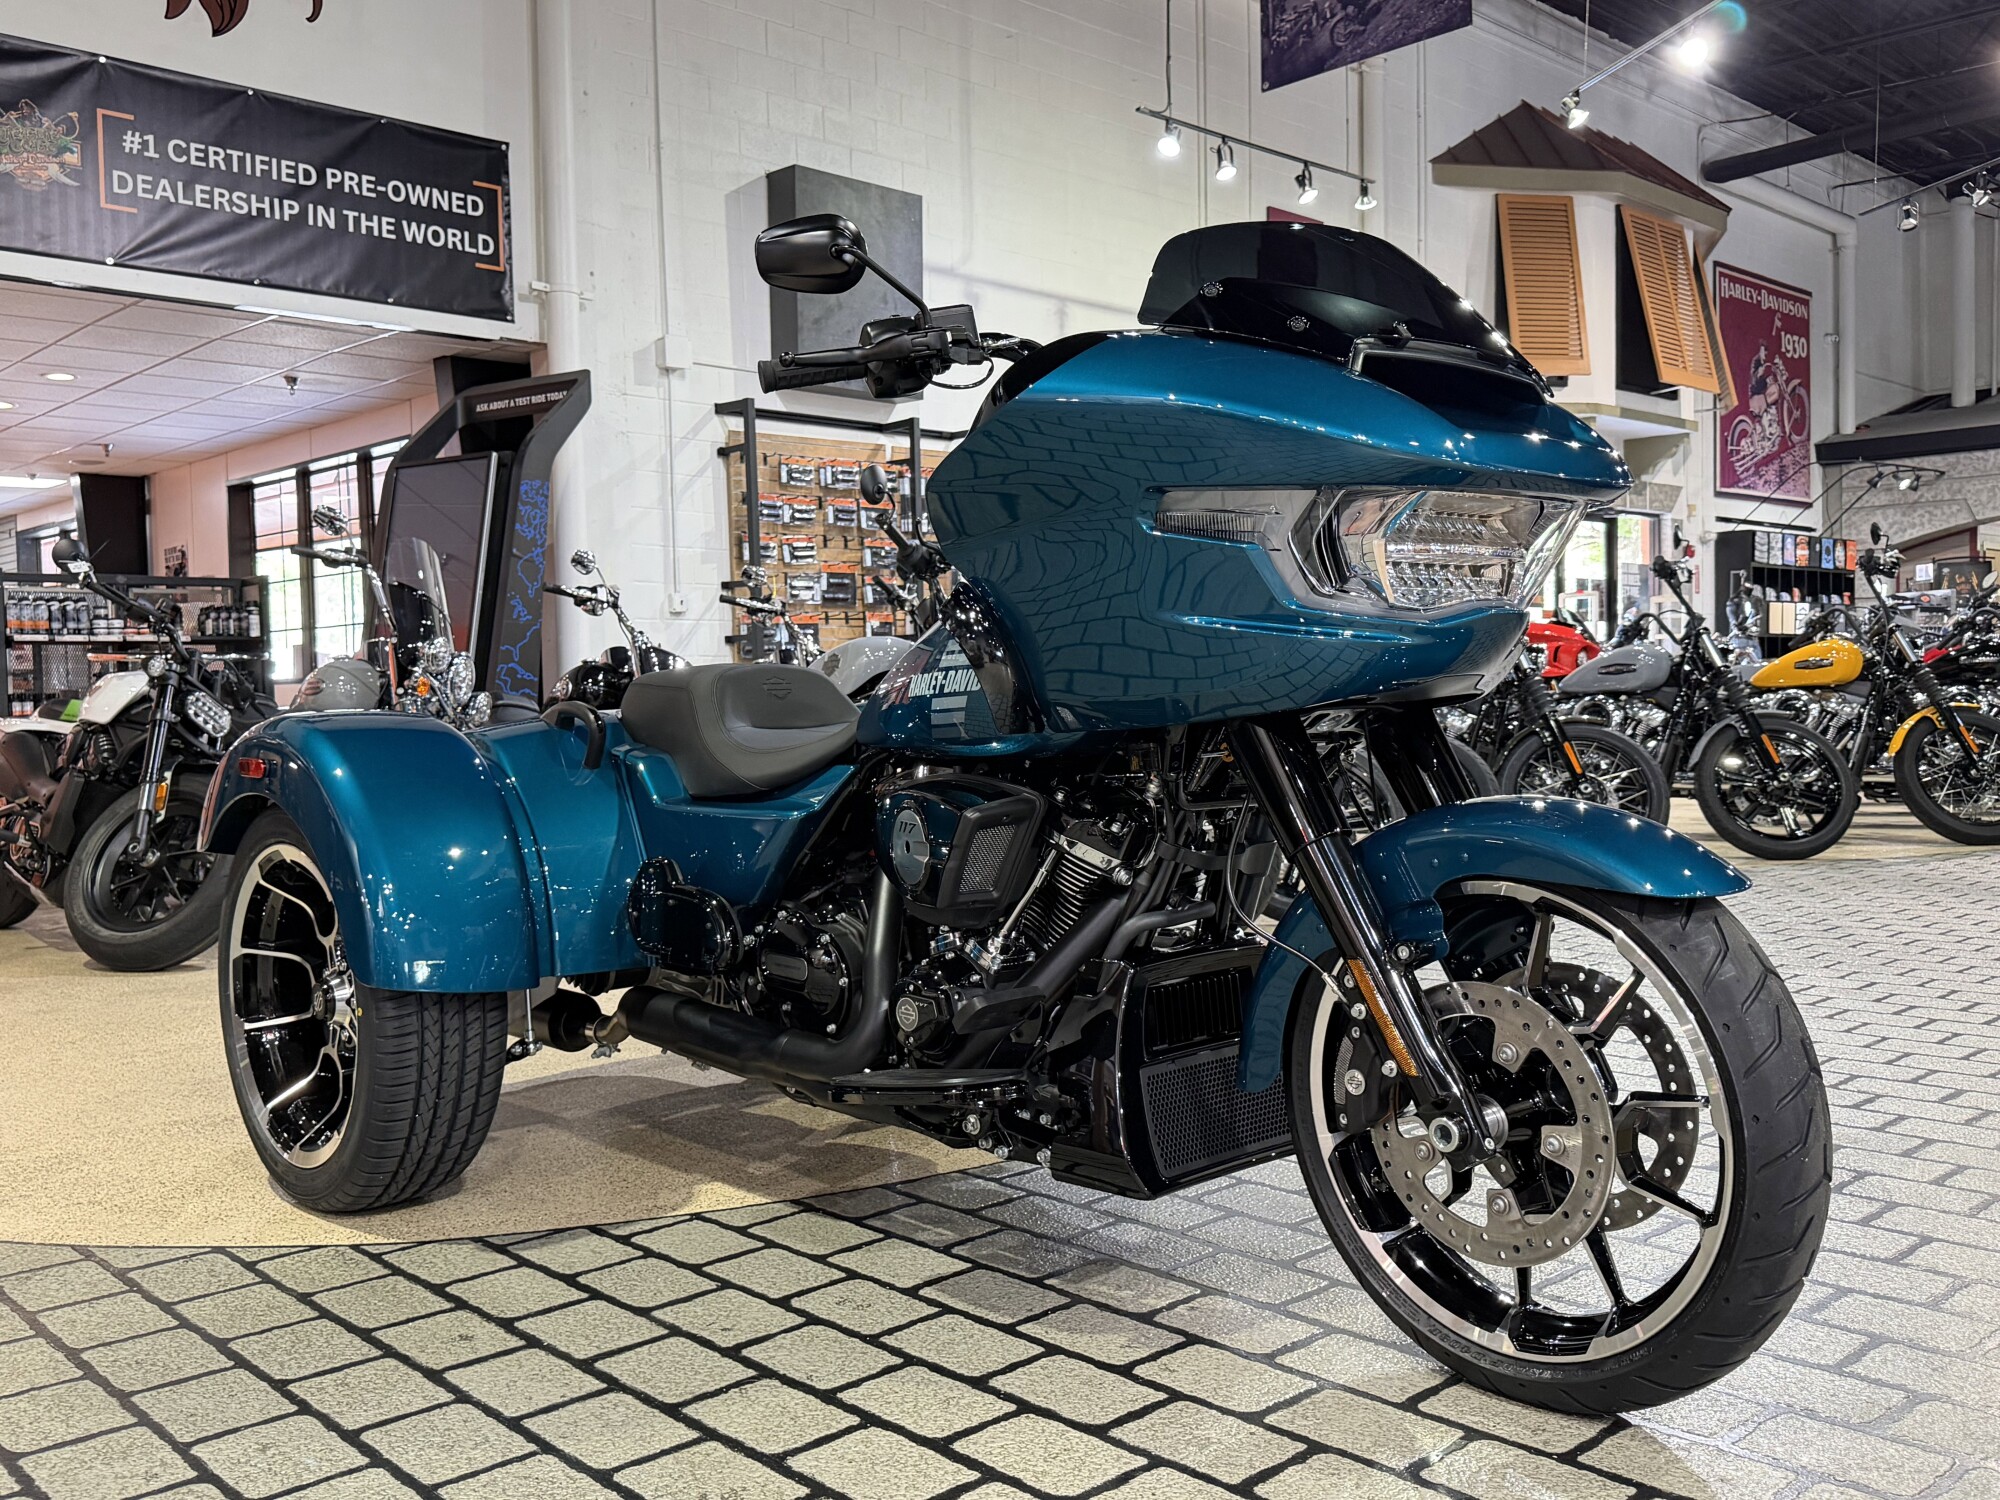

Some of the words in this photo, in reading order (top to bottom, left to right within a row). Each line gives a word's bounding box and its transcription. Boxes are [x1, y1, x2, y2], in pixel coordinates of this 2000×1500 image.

[122, 130, 160, 158] #1
[167, 138, 318, 187] CERTIFIED
[325, 167, 485, 217] PRE-OWNED
[112, 169, 300, 222] DEALERSHIP
[308, 203, 336, 230] IN
[342, 209, 397, 240] THE
[401, 219, 495, 256] WORLD
[1780, 331, 1808, 359] 1930
[476, 403, 488, 412] ASK
[489, 400, 509, 410] ABOUT
[515, 397, 530, 406] TEST
[531, 395, 546, 404] RIDE
[546, 391, 567, 401] TODAY
[898, 820, 918, 834] 117
